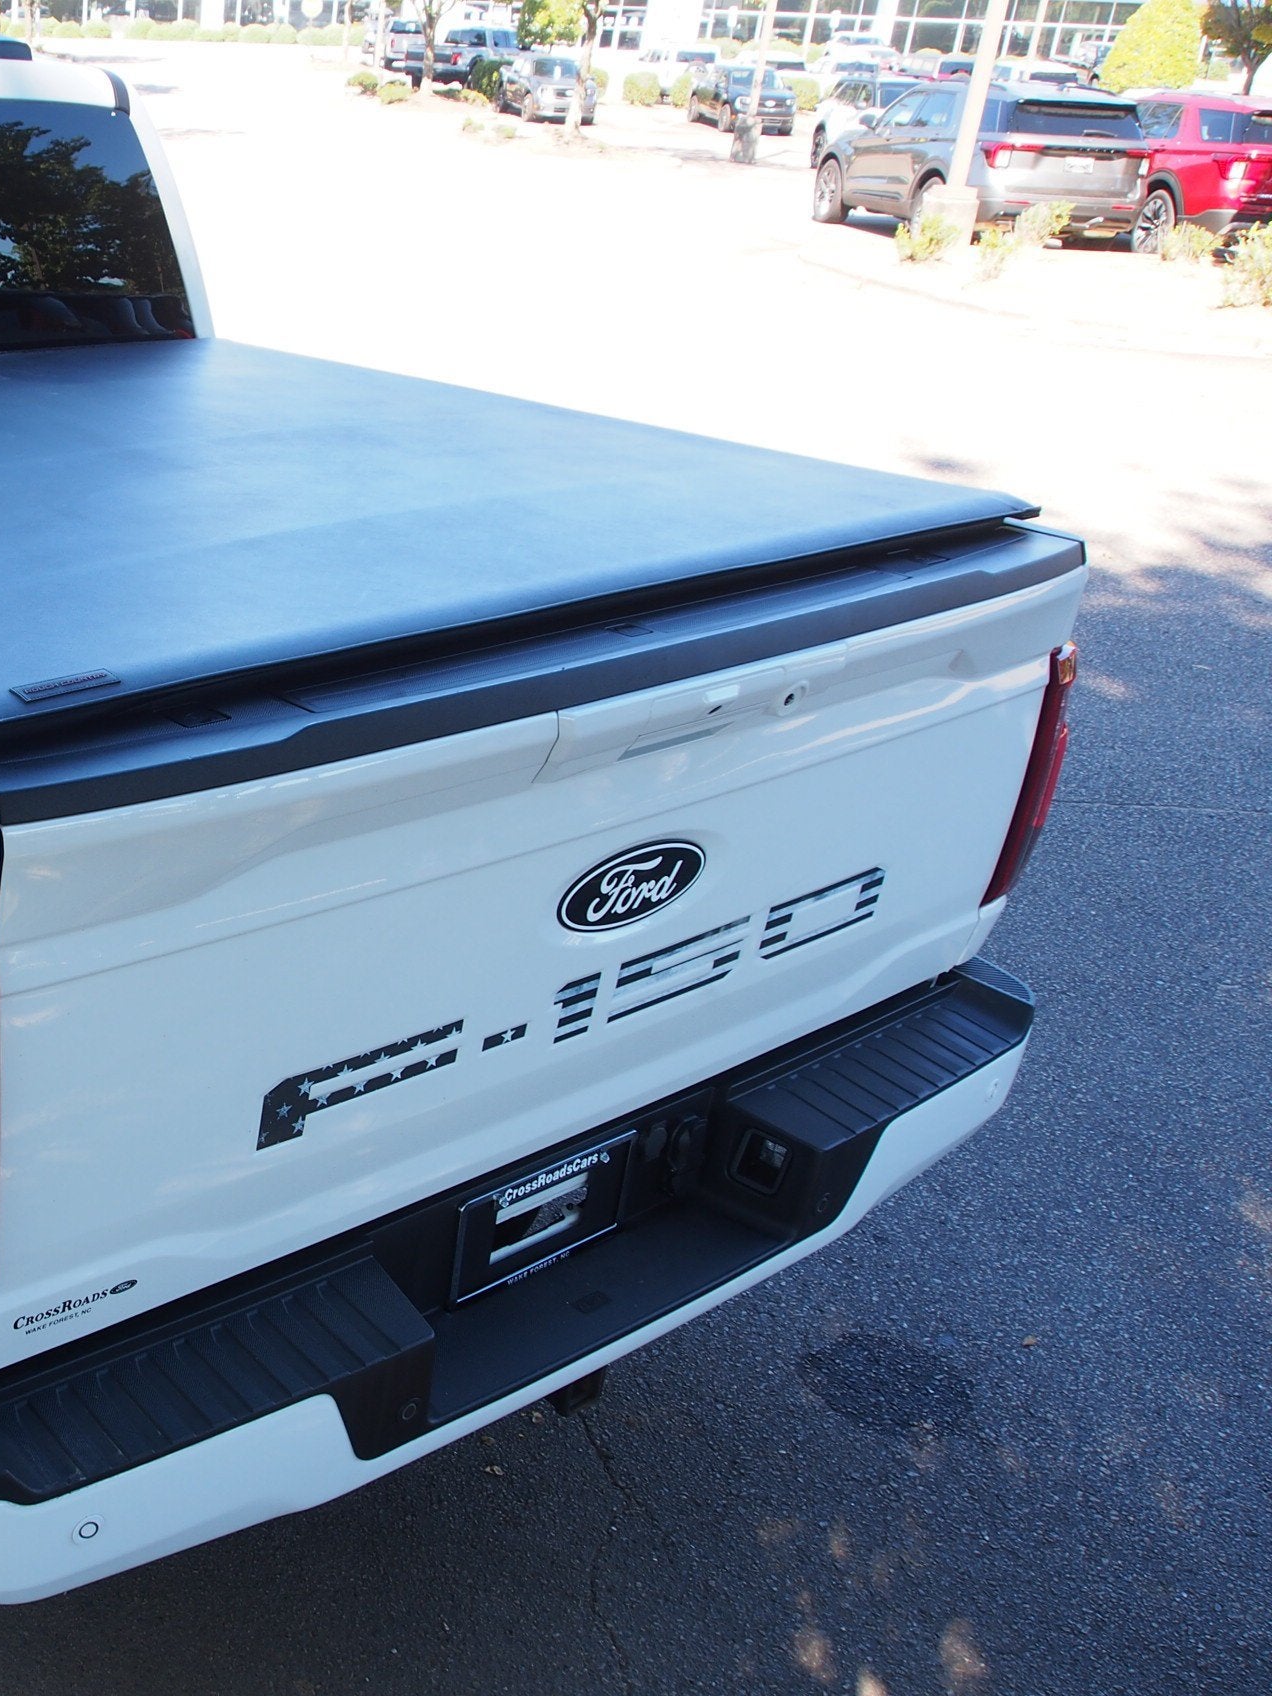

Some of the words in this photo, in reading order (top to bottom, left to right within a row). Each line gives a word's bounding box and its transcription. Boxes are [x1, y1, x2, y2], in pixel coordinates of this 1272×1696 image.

[584, 853, 685, 923] Ford
[255, 866, 886, 1151] F-150
[507, 1271, 528, 1285] WAKE
[560, 1250, 570, 1260] NC
[25, 1324, 47, 1335] WAKE
[81, 1307, 92, 1316] NC
